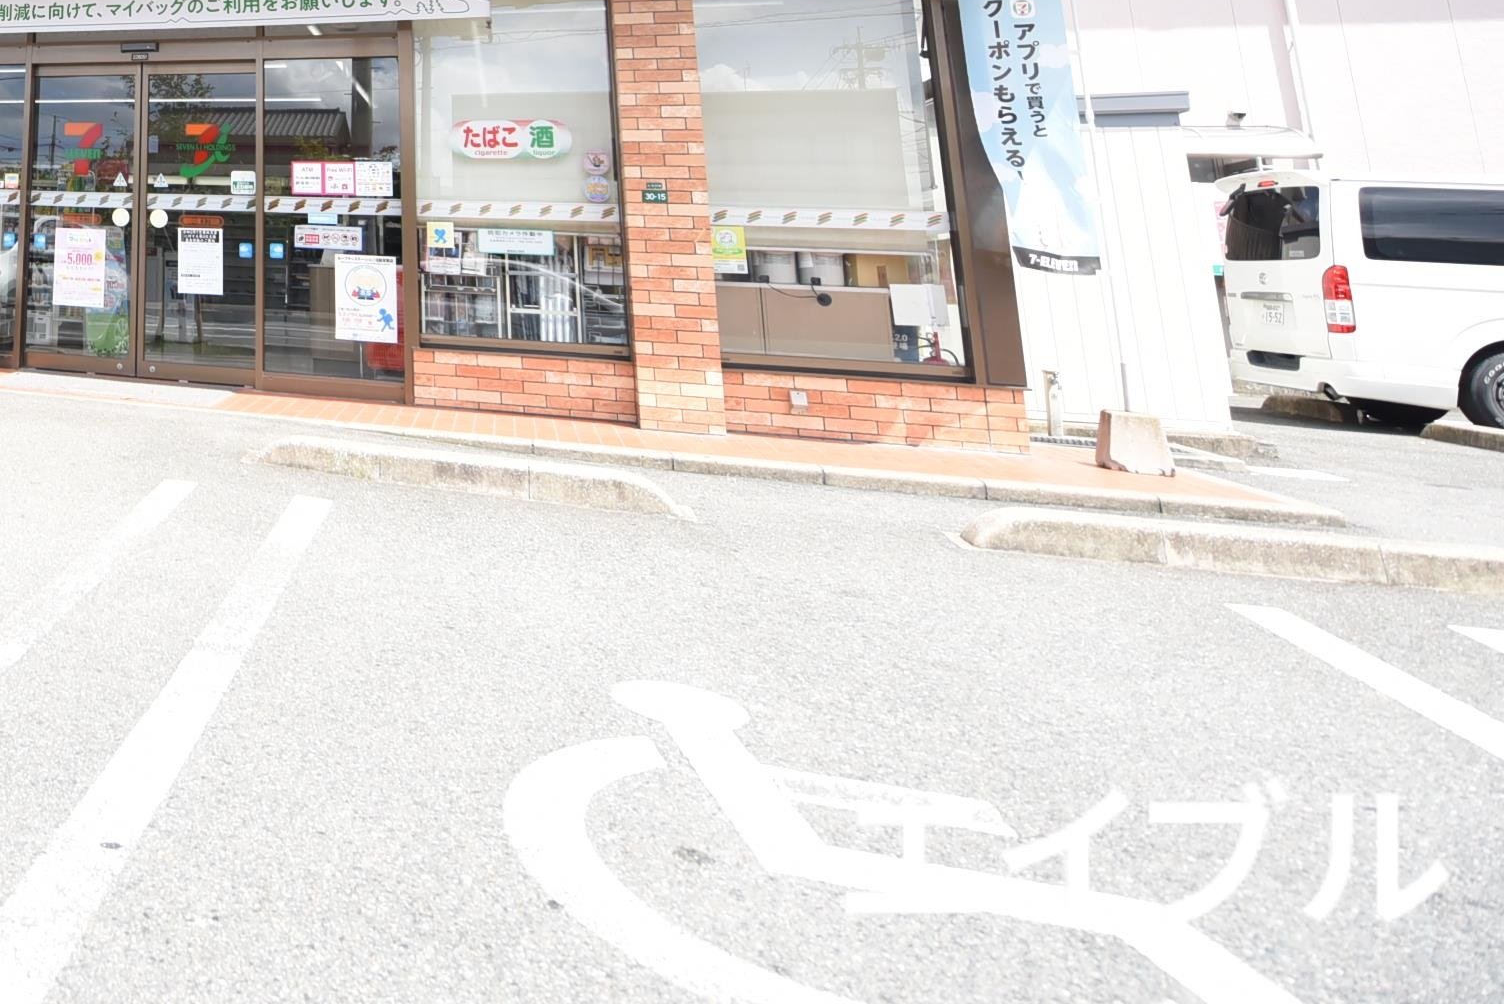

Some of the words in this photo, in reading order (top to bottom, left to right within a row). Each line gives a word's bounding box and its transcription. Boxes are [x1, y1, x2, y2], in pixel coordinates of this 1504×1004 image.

[1013, 23, 1048, 138] アプリで買うと
[463, 126, 518, 148] たばこ
[529, 126, 554, 148] 酒
[644, 192, 667, 201] 30-15
